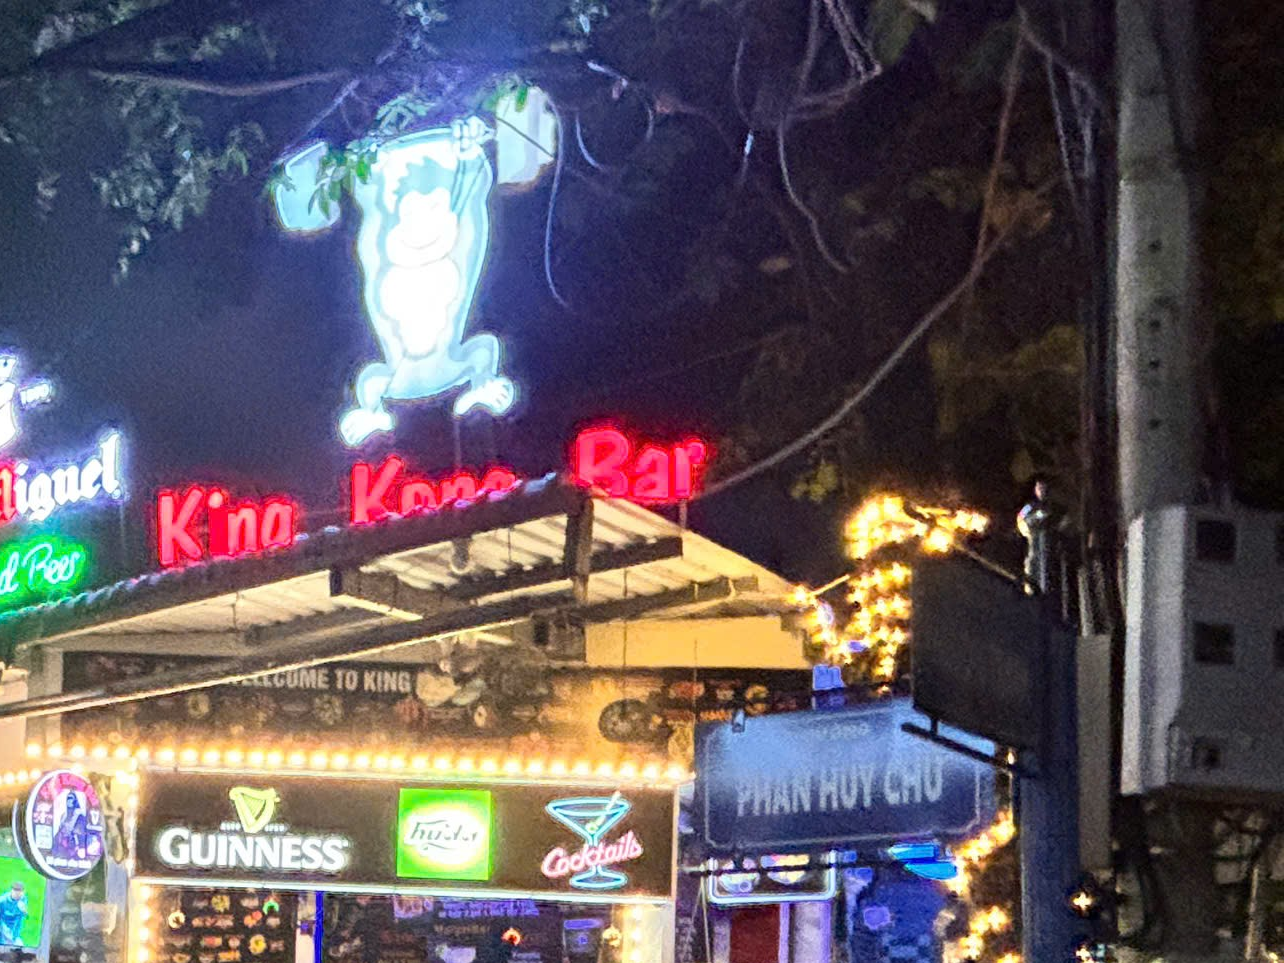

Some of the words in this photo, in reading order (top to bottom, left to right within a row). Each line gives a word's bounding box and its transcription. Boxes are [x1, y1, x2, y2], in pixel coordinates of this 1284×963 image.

[575, 427, 706, 499] Bar
[234, 667, 330, 691] LCOME
[335, 668, 359, 692] TO
[363, 670, 412, 694] KING
[818, 762, 875, 813] HUY
[158, 826, 349, 871] GUINNESS
[541, 828, 644, 879] Cocktails
